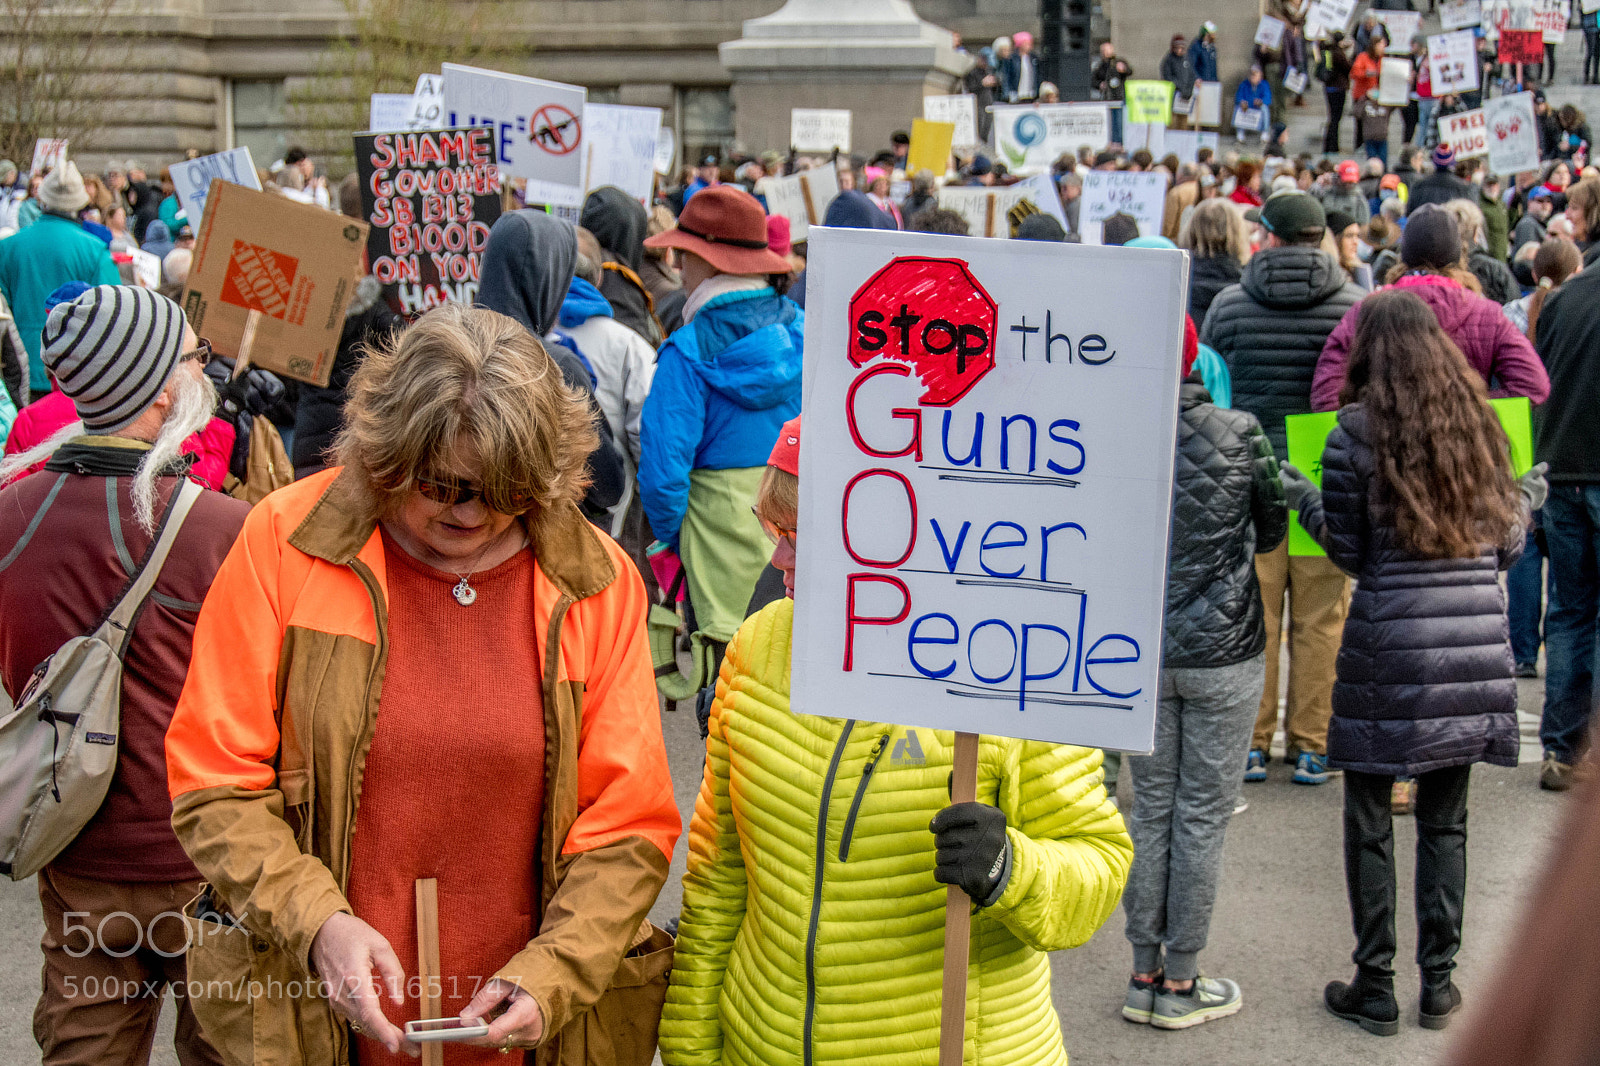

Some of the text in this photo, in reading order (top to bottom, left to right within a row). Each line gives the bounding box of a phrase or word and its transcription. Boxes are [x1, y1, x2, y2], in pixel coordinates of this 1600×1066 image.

[370, 129, 491, 169] SHAME
[370, 193, 475, 228] SB 1313
[231, 243, 287, 315] HOME
[232, 272, 255, 303] THE
[258, 249, 291, 294] DEPOT
[373, 253, 421, 285] ON
[857, 303, 1116, 374] stop the
[846, 363, 1087, 476] Guns
[841, 467, 1087, 584] Over
[843, 572, 1143, 711] People
